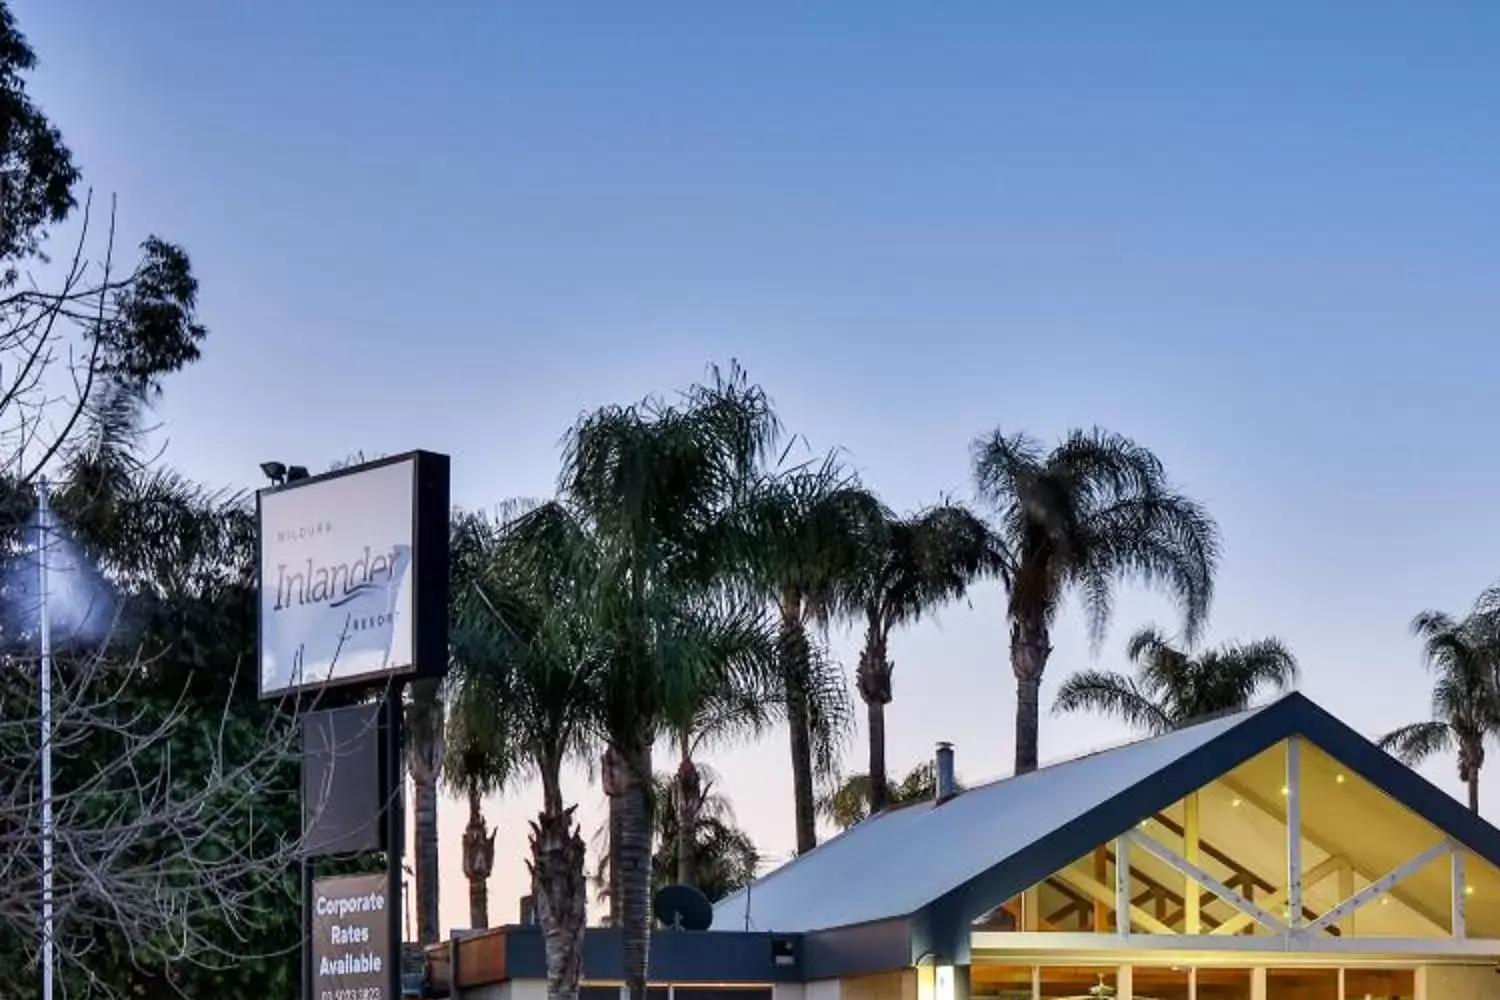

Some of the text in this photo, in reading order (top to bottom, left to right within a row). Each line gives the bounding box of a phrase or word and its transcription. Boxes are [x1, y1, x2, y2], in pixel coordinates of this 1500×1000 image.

[273, 546, 398, 611] Inlander
[317, 892, 384, 918] Corporate
[331, 924, 369, 945] Rates
[319, 952, 382, 977] Available
